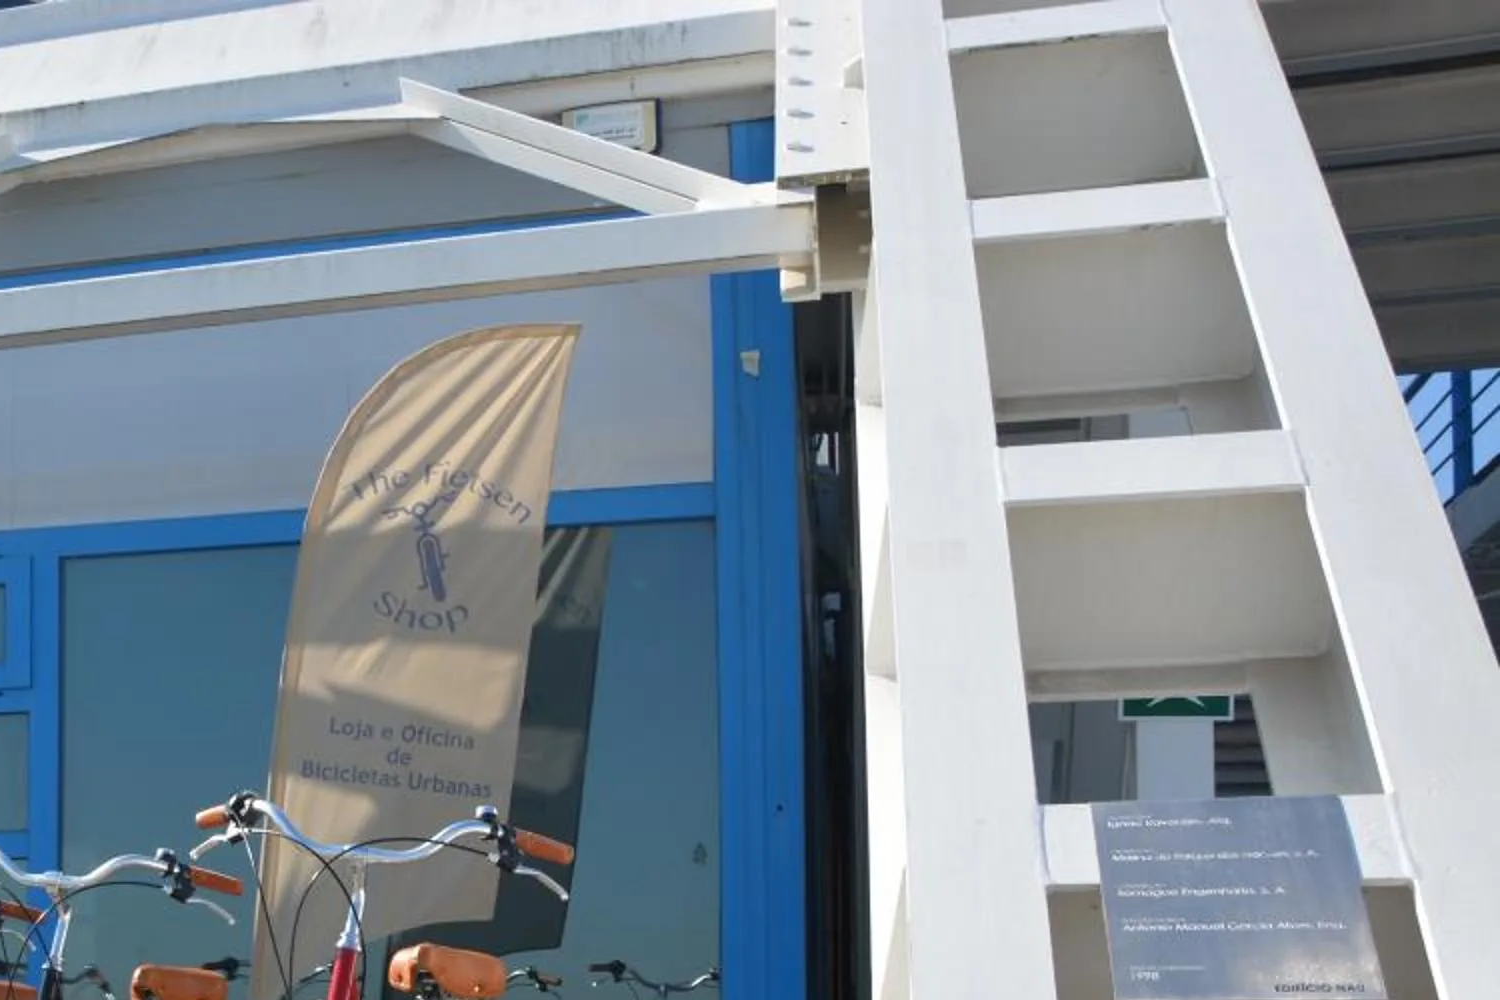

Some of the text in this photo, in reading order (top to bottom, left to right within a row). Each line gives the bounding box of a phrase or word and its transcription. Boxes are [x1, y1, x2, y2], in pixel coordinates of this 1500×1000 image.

[352, 470, 409, 500] The
[373, 591, 468, 633] Shop
[329, 717, 475, 749] Loja e Oficina
[387, 748, 412, 765] de
[301, 759, 491, 798] Bicicletas Urbanas
